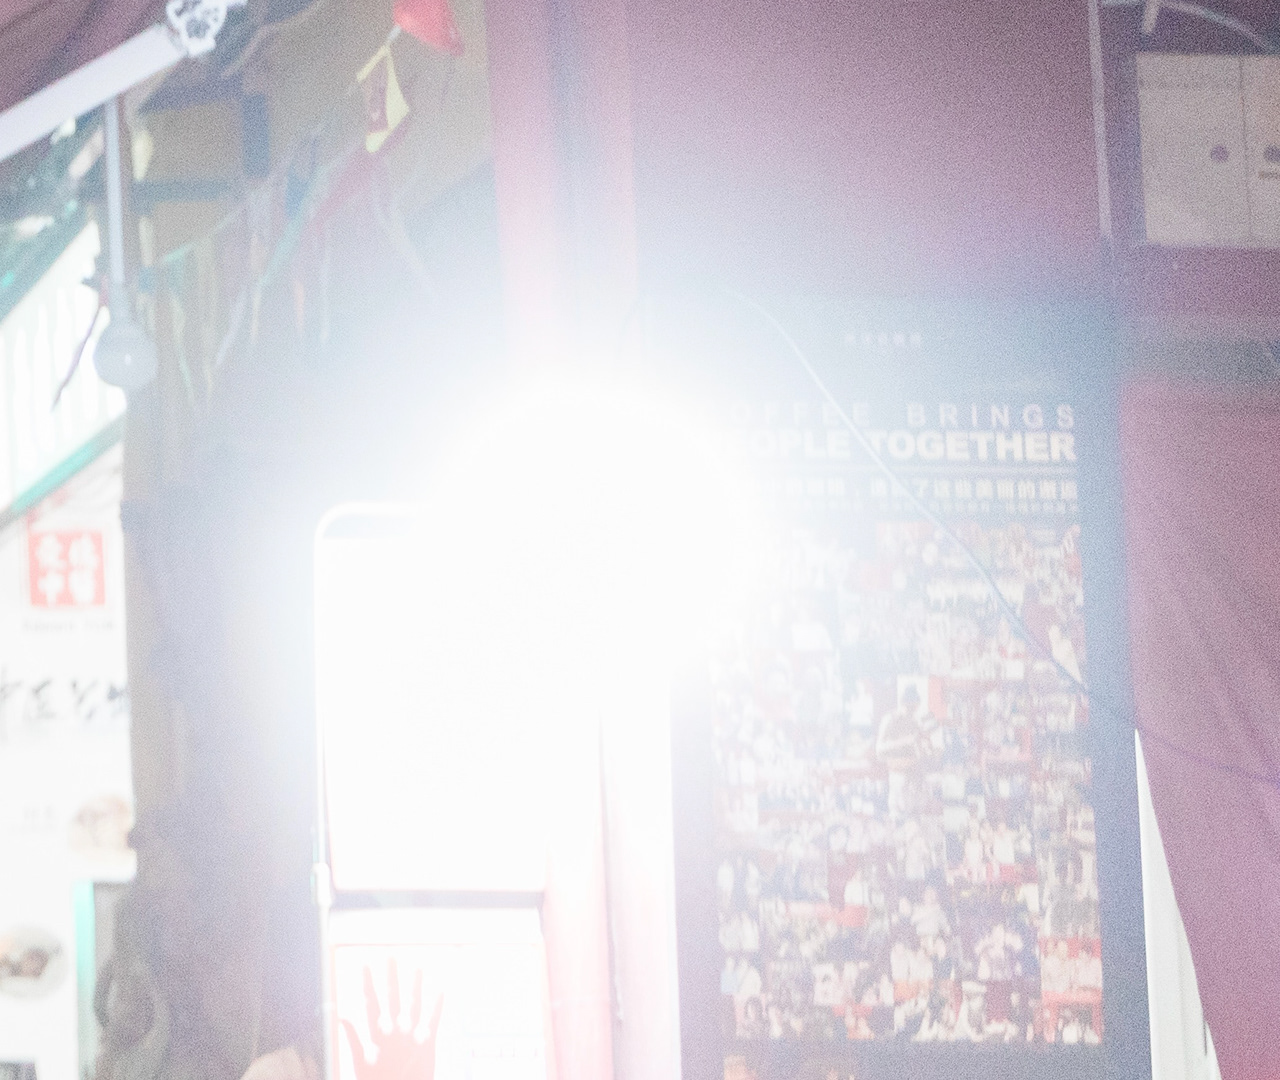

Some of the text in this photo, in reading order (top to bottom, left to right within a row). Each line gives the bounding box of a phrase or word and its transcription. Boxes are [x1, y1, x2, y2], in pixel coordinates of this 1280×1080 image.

[710, 402, 1076, 428] OFFEE BRINGS
[865, 431, 1077, 462] TOGETHER
